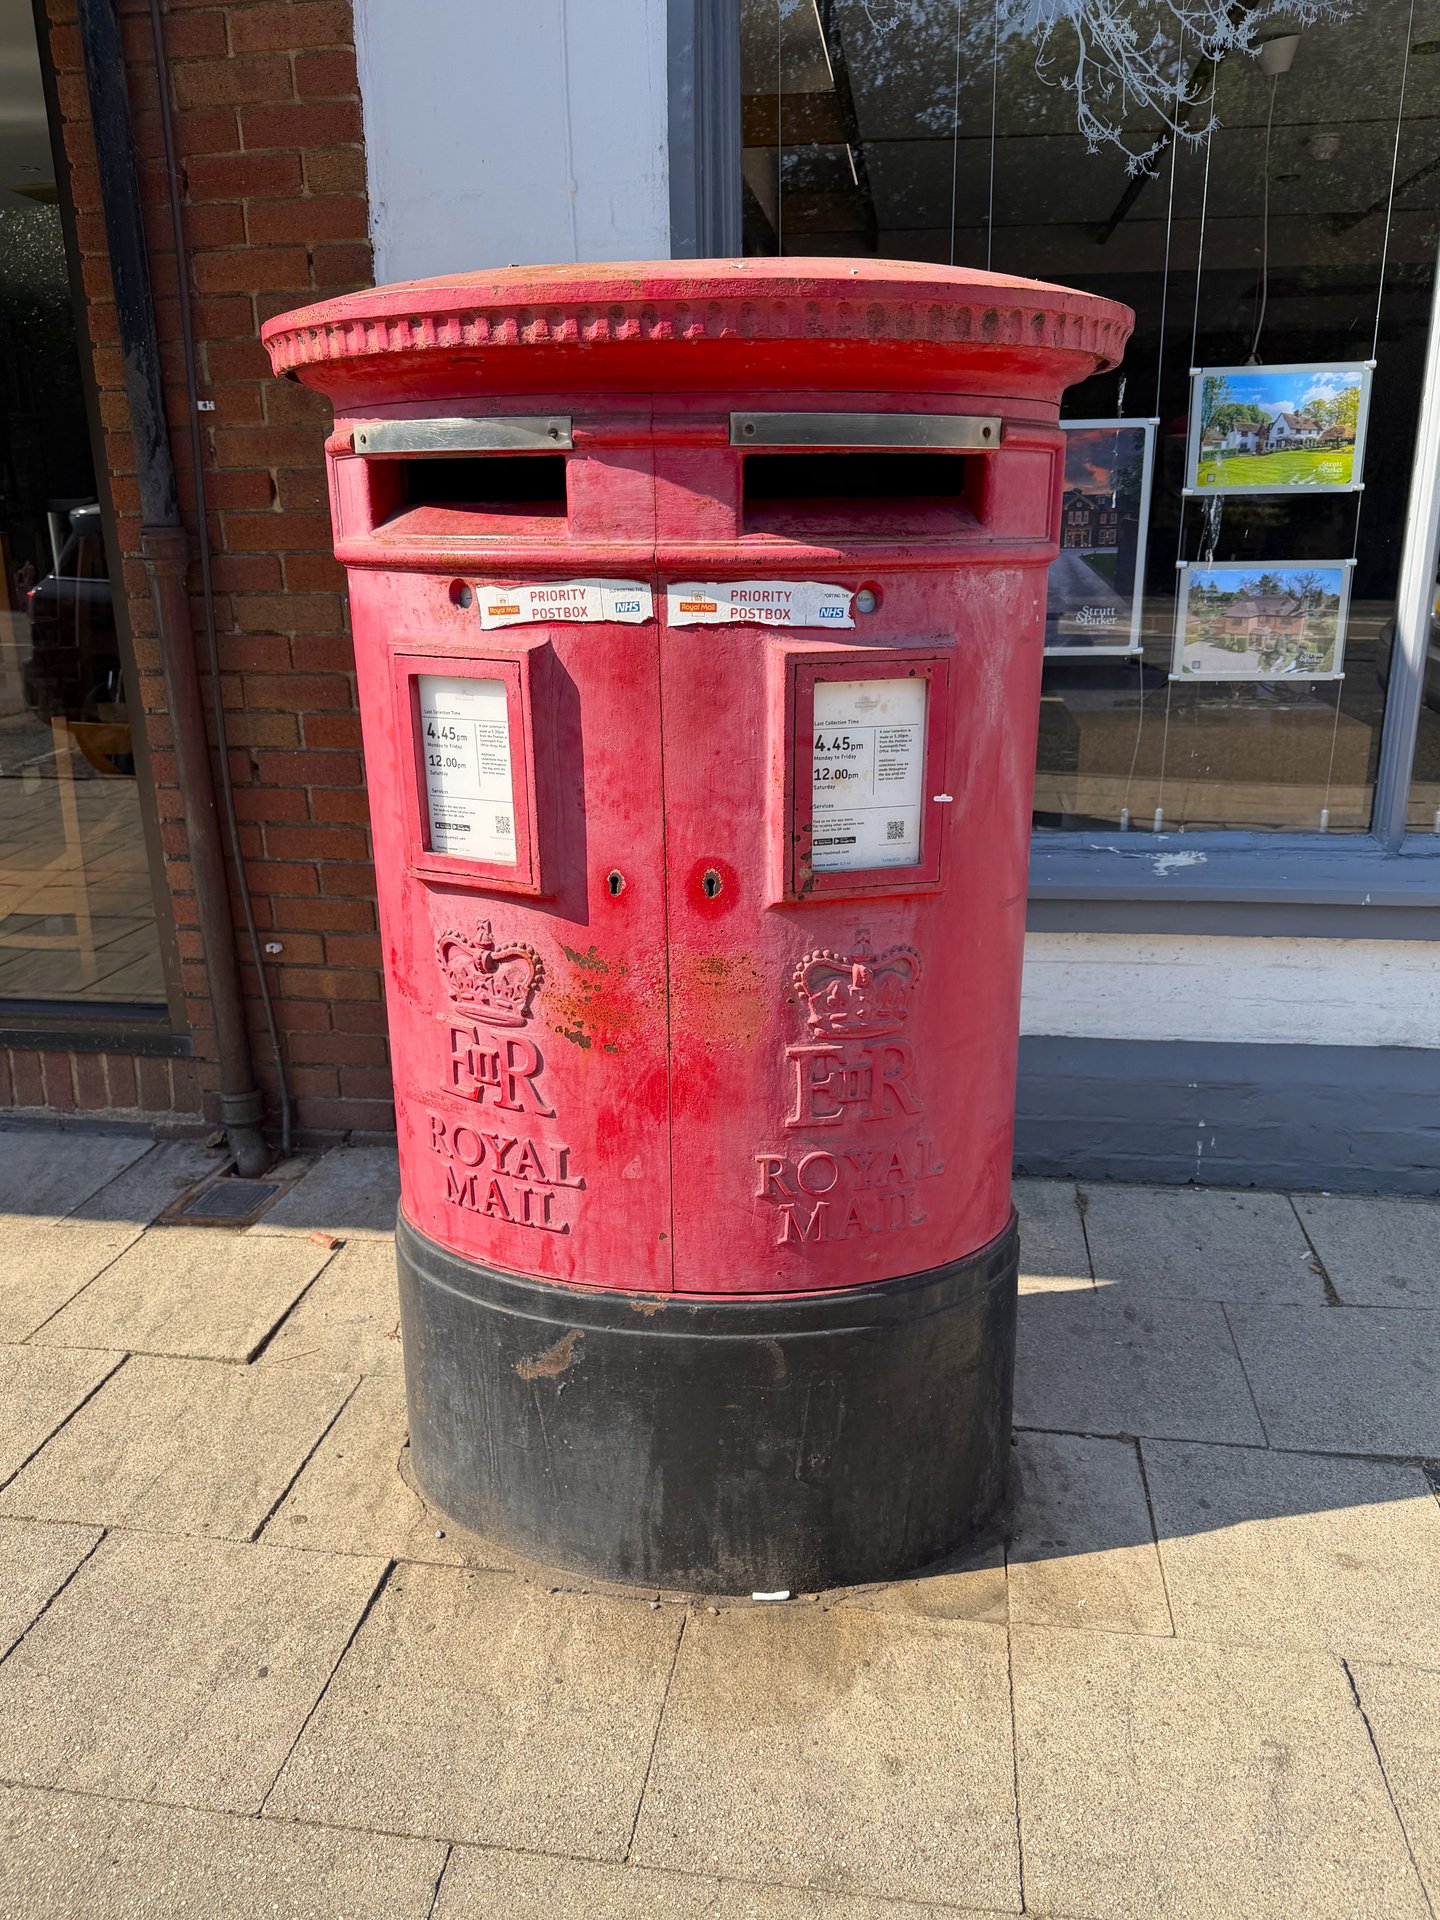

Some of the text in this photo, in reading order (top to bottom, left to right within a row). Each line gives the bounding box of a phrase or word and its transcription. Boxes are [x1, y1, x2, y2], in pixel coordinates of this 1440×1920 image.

[530, 588, 586, 602] PRIORITY
[730, 590, 792, 602] PRIORITY
[532, 606, 588, 620] POSTBOX
[616, 602, 639, 612] NHS
[681, 602, 716, 612] Royal Mail
[730, 607, 791, 620] POSTBOX
[820, 608, 844, 618] NHS
[1082, 606, 1116, 616] Strutt
[427, 722, 468, 742] 4.45pm
[814, 734, 864, 752] 4.45pm
[429, 754, 466, 769] 12.00pm
[814, 767, 858, 781] 12.00pm
[427, 1110, 586, 1191] ROYAL
[755, 1136, 945, 1198] ROYAL
[442, 1160, 570, 1235] MAIL
[777, 1187, 929, 1245] MAIL
